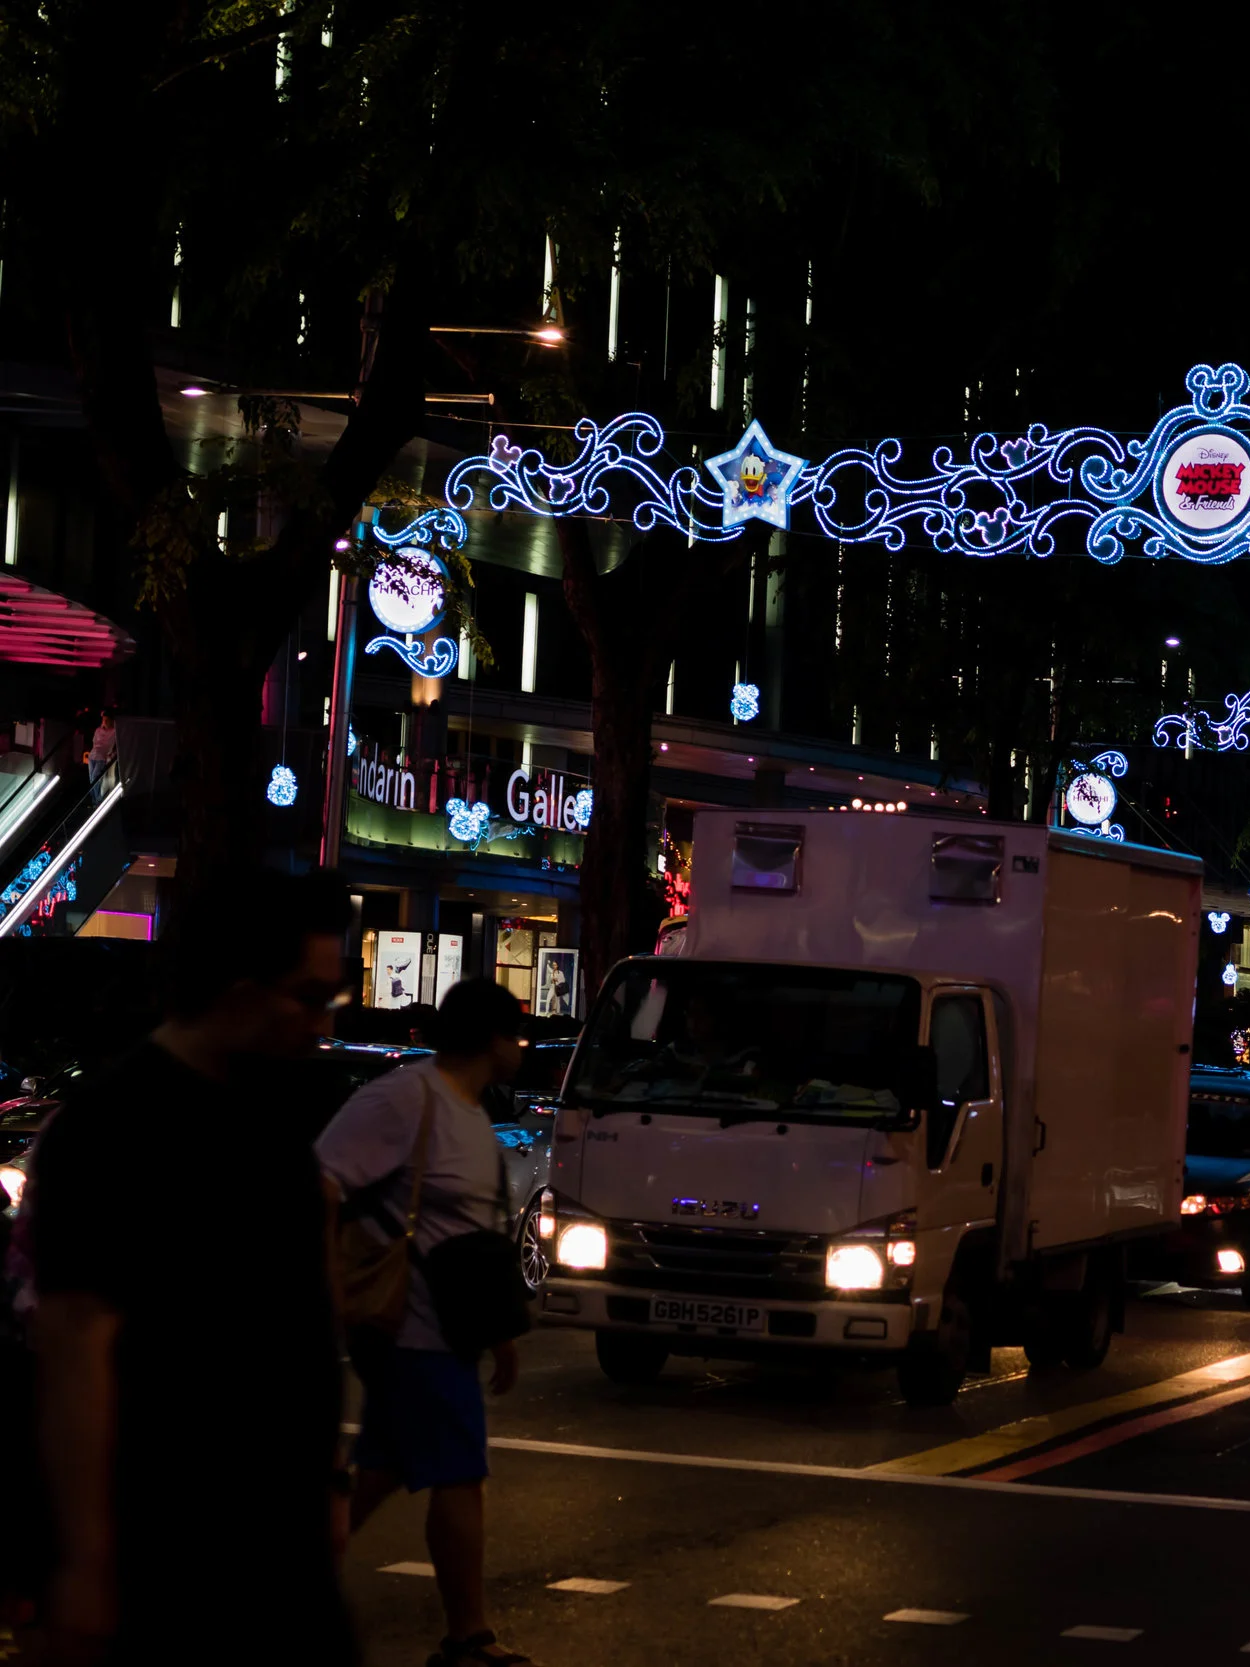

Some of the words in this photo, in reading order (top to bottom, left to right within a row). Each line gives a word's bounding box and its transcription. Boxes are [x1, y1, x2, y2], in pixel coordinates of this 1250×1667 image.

[1175, 462, 1246, 480] MICKEY
[1176, 479, 1242, 496] MOUSE
[1179, 495, 1194, 510] &
[1194, 495, 1235, 510] Friends
[379, 584, 434, 596] HIACHI
[357, 742, 416, 809] ndarin
[507, 769, 583, 832] Galle
[671, 1197, 760, 1220] ISUZU
[655, 1301, 759, 1326] GBH5261P
